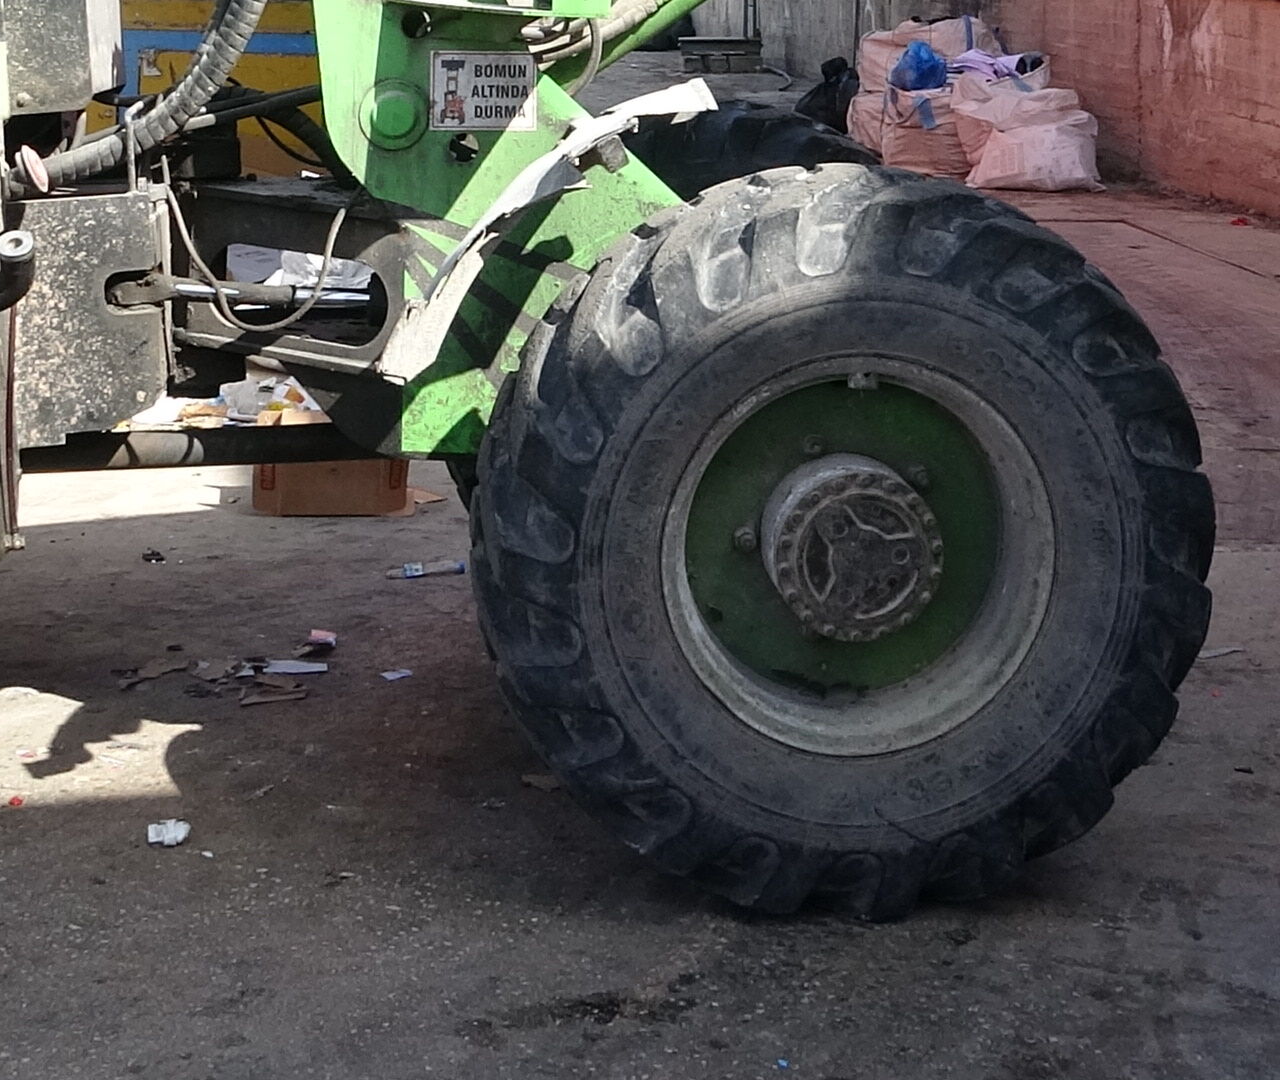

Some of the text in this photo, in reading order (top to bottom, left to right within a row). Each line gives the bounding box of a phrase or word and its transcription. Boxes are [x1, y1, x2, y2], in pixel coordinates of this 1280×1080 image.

[474, 63, 527, 79] BOMUN
[471, 84, 529, 99] ALTINDA
[474, 105, 526, 119] DURMA
